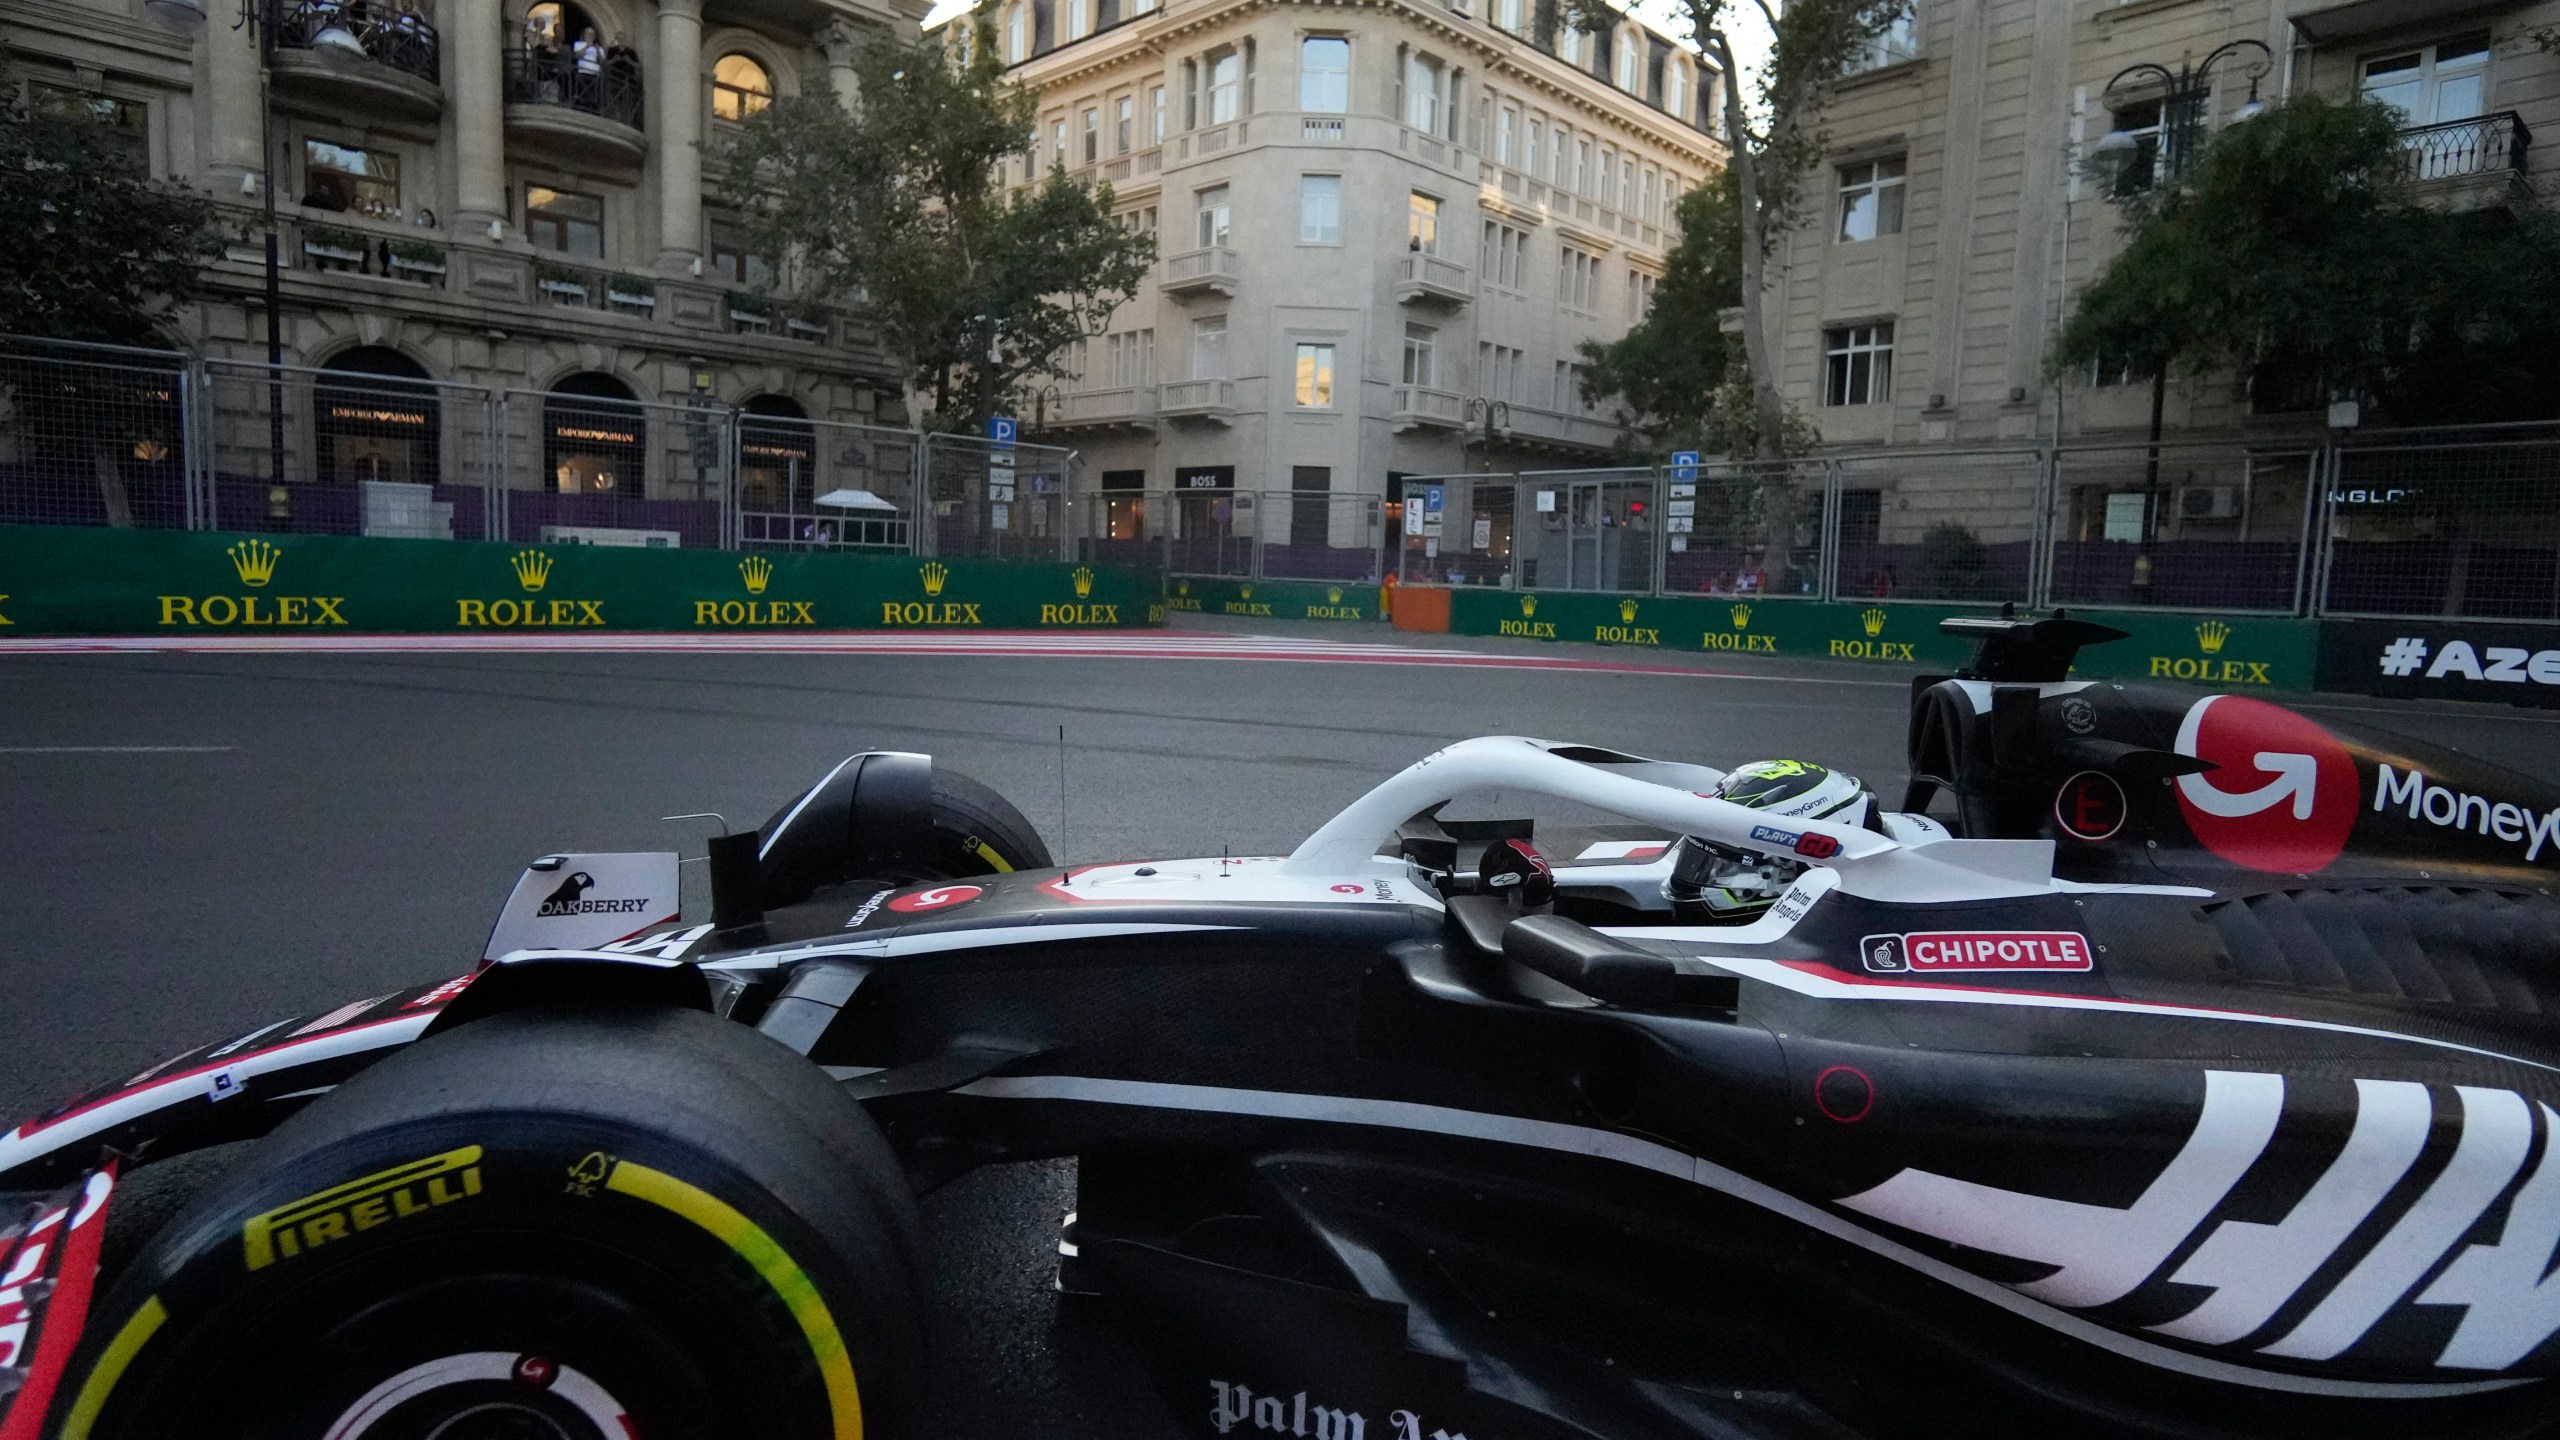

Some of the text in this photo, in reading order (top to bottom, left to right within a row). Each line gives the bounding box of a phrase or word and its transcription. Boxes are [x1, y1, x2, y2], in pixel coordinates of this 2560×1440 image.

[1190, 475, 1217, 488] BOSS
[157, 595, 348, 625] ROLEX
[457, 599, 606, 626] ROLEX
[695, 601, 815, 625] ROLEX
[882, 602, 981, 625] ROLEX
[1040, 604, 1118, 624] ROLEX
[1225, 602, 1272, 616] ROLEX
[1307, 605, 1361, 620] ROLEX
[1500, 620, 1556, 638] ROLEX
[1595, 626, 1660, 645] ROLEX
[1702, 632, 1777, 653] ROLEX
[1829, 639, 1915, 662] ROLEX
[2150, 656, 2271, 685] ROLEX
[1777, 795, 1829, 817] neyGram
[2373, 763, 2560, 862] Money
[537, 898, 649, 917] OAKBERRY
[1785, 887, 1811, 906] Palm
[1770, 899, 1802, 922] Angels
[1915, 940, 2082, 964] CHIPOTLE
[243, 1144, 483, 1272] PIRELLI
[1209, 1378, 1368, 1440] Palm
